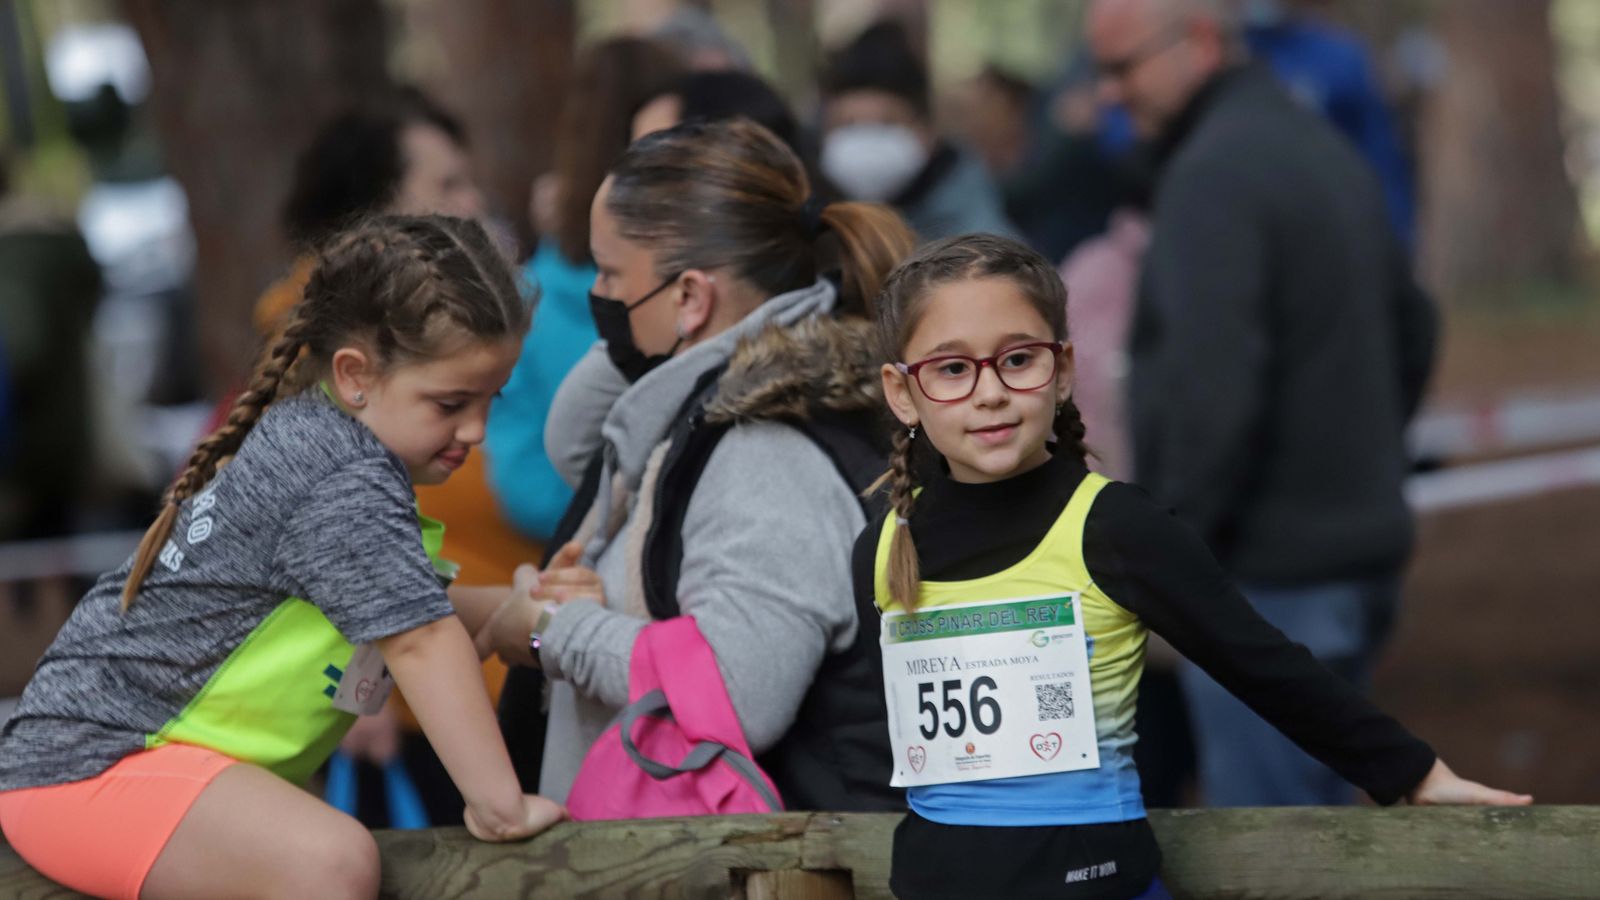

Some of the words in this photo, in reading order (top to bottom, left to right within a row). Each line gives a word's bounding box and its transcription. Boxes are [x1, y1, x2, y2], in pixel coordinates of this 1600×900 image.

[899, 617, 935, 637] CROSS
[938, 612, 984, 633] PINAR
[988, 609, 1023, 628] DEL
[1025, 603, 1060, 623] REY
[906, 656, 962, 676] MIREYA
[965, 658, 1008, 670] ESTRADA
[1009, 655, 1039, 665] MOYA
[918, 675, 1002, 741] 556
